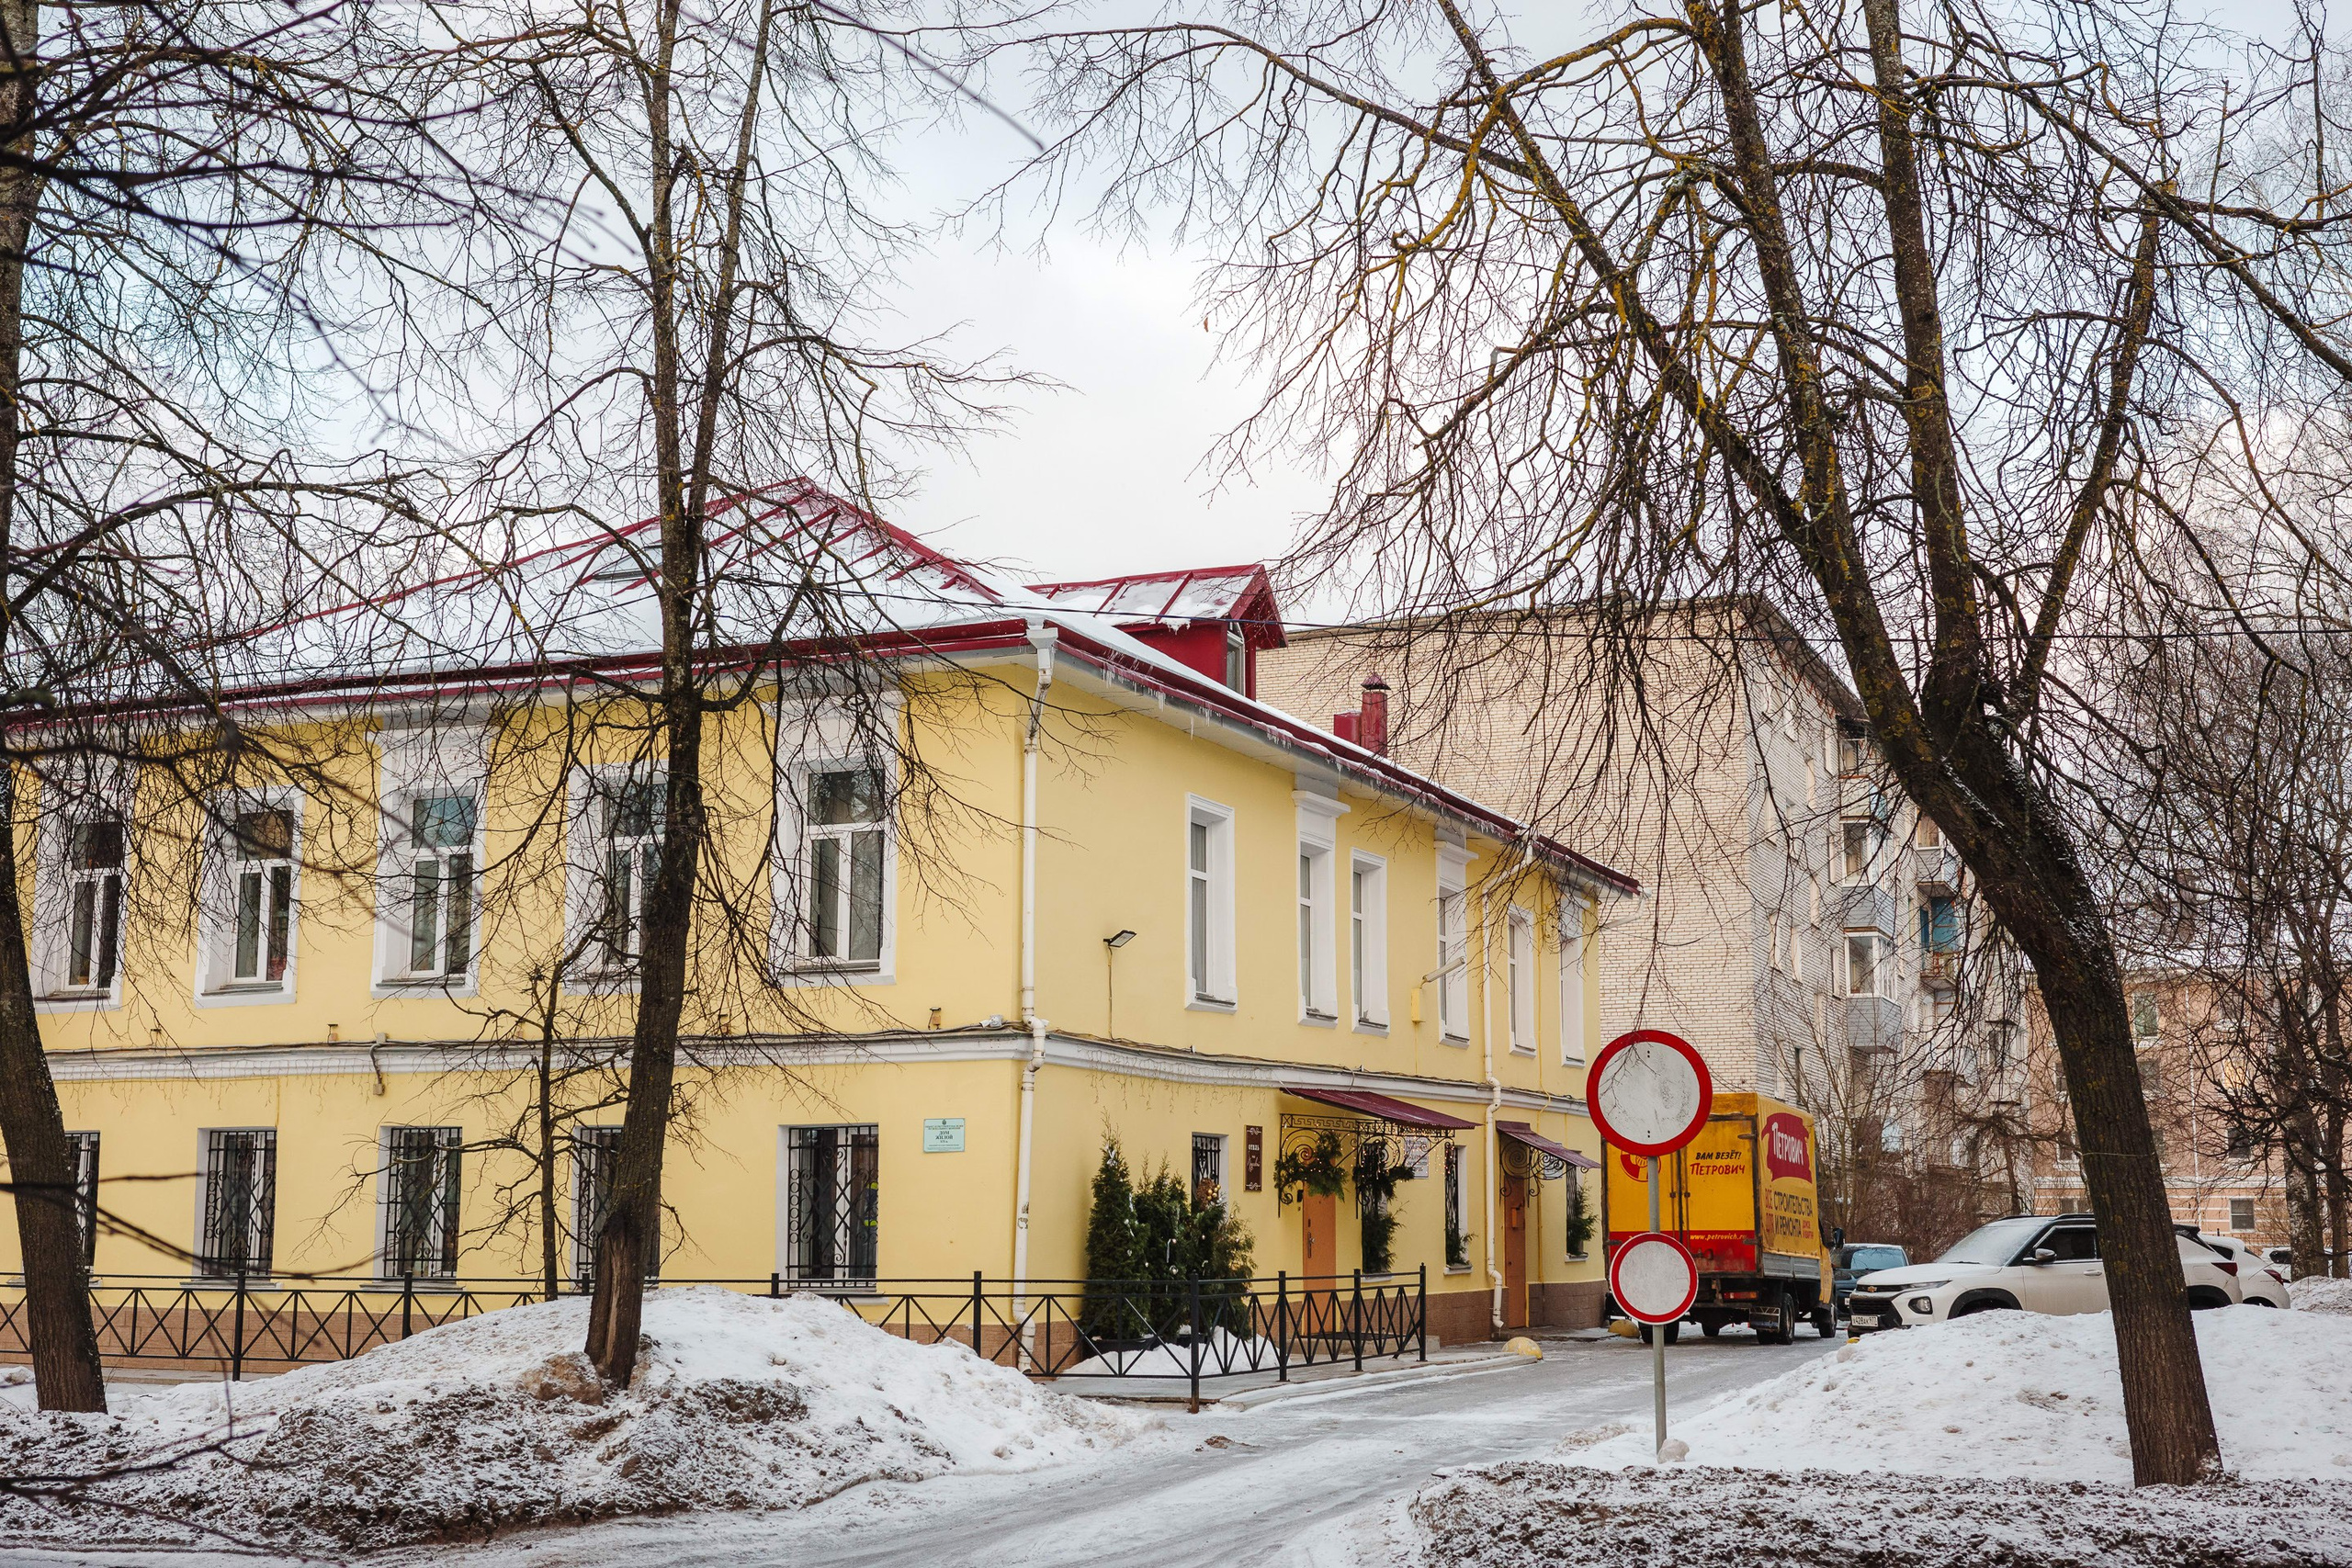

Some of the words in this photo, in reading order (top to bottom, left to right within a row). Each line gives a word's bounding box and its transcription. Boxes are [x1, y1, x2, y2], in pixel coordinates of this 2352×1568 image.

[1695, 1152, 1713, 1160] ВАМ
[1714, 1149, 1742, 1160] ВЕЗЁТ!
[1771, 1122, 1804, 1166] ПЕТРОВИЧ
[1690, 1162, 1746, 1176] ПЕТРОВИЧ
[1773, 1190, 1814, 1217] СТРОИТЕЛЬСТВА
[1780, 1215, 1802, 1238] РЕМОНТА
